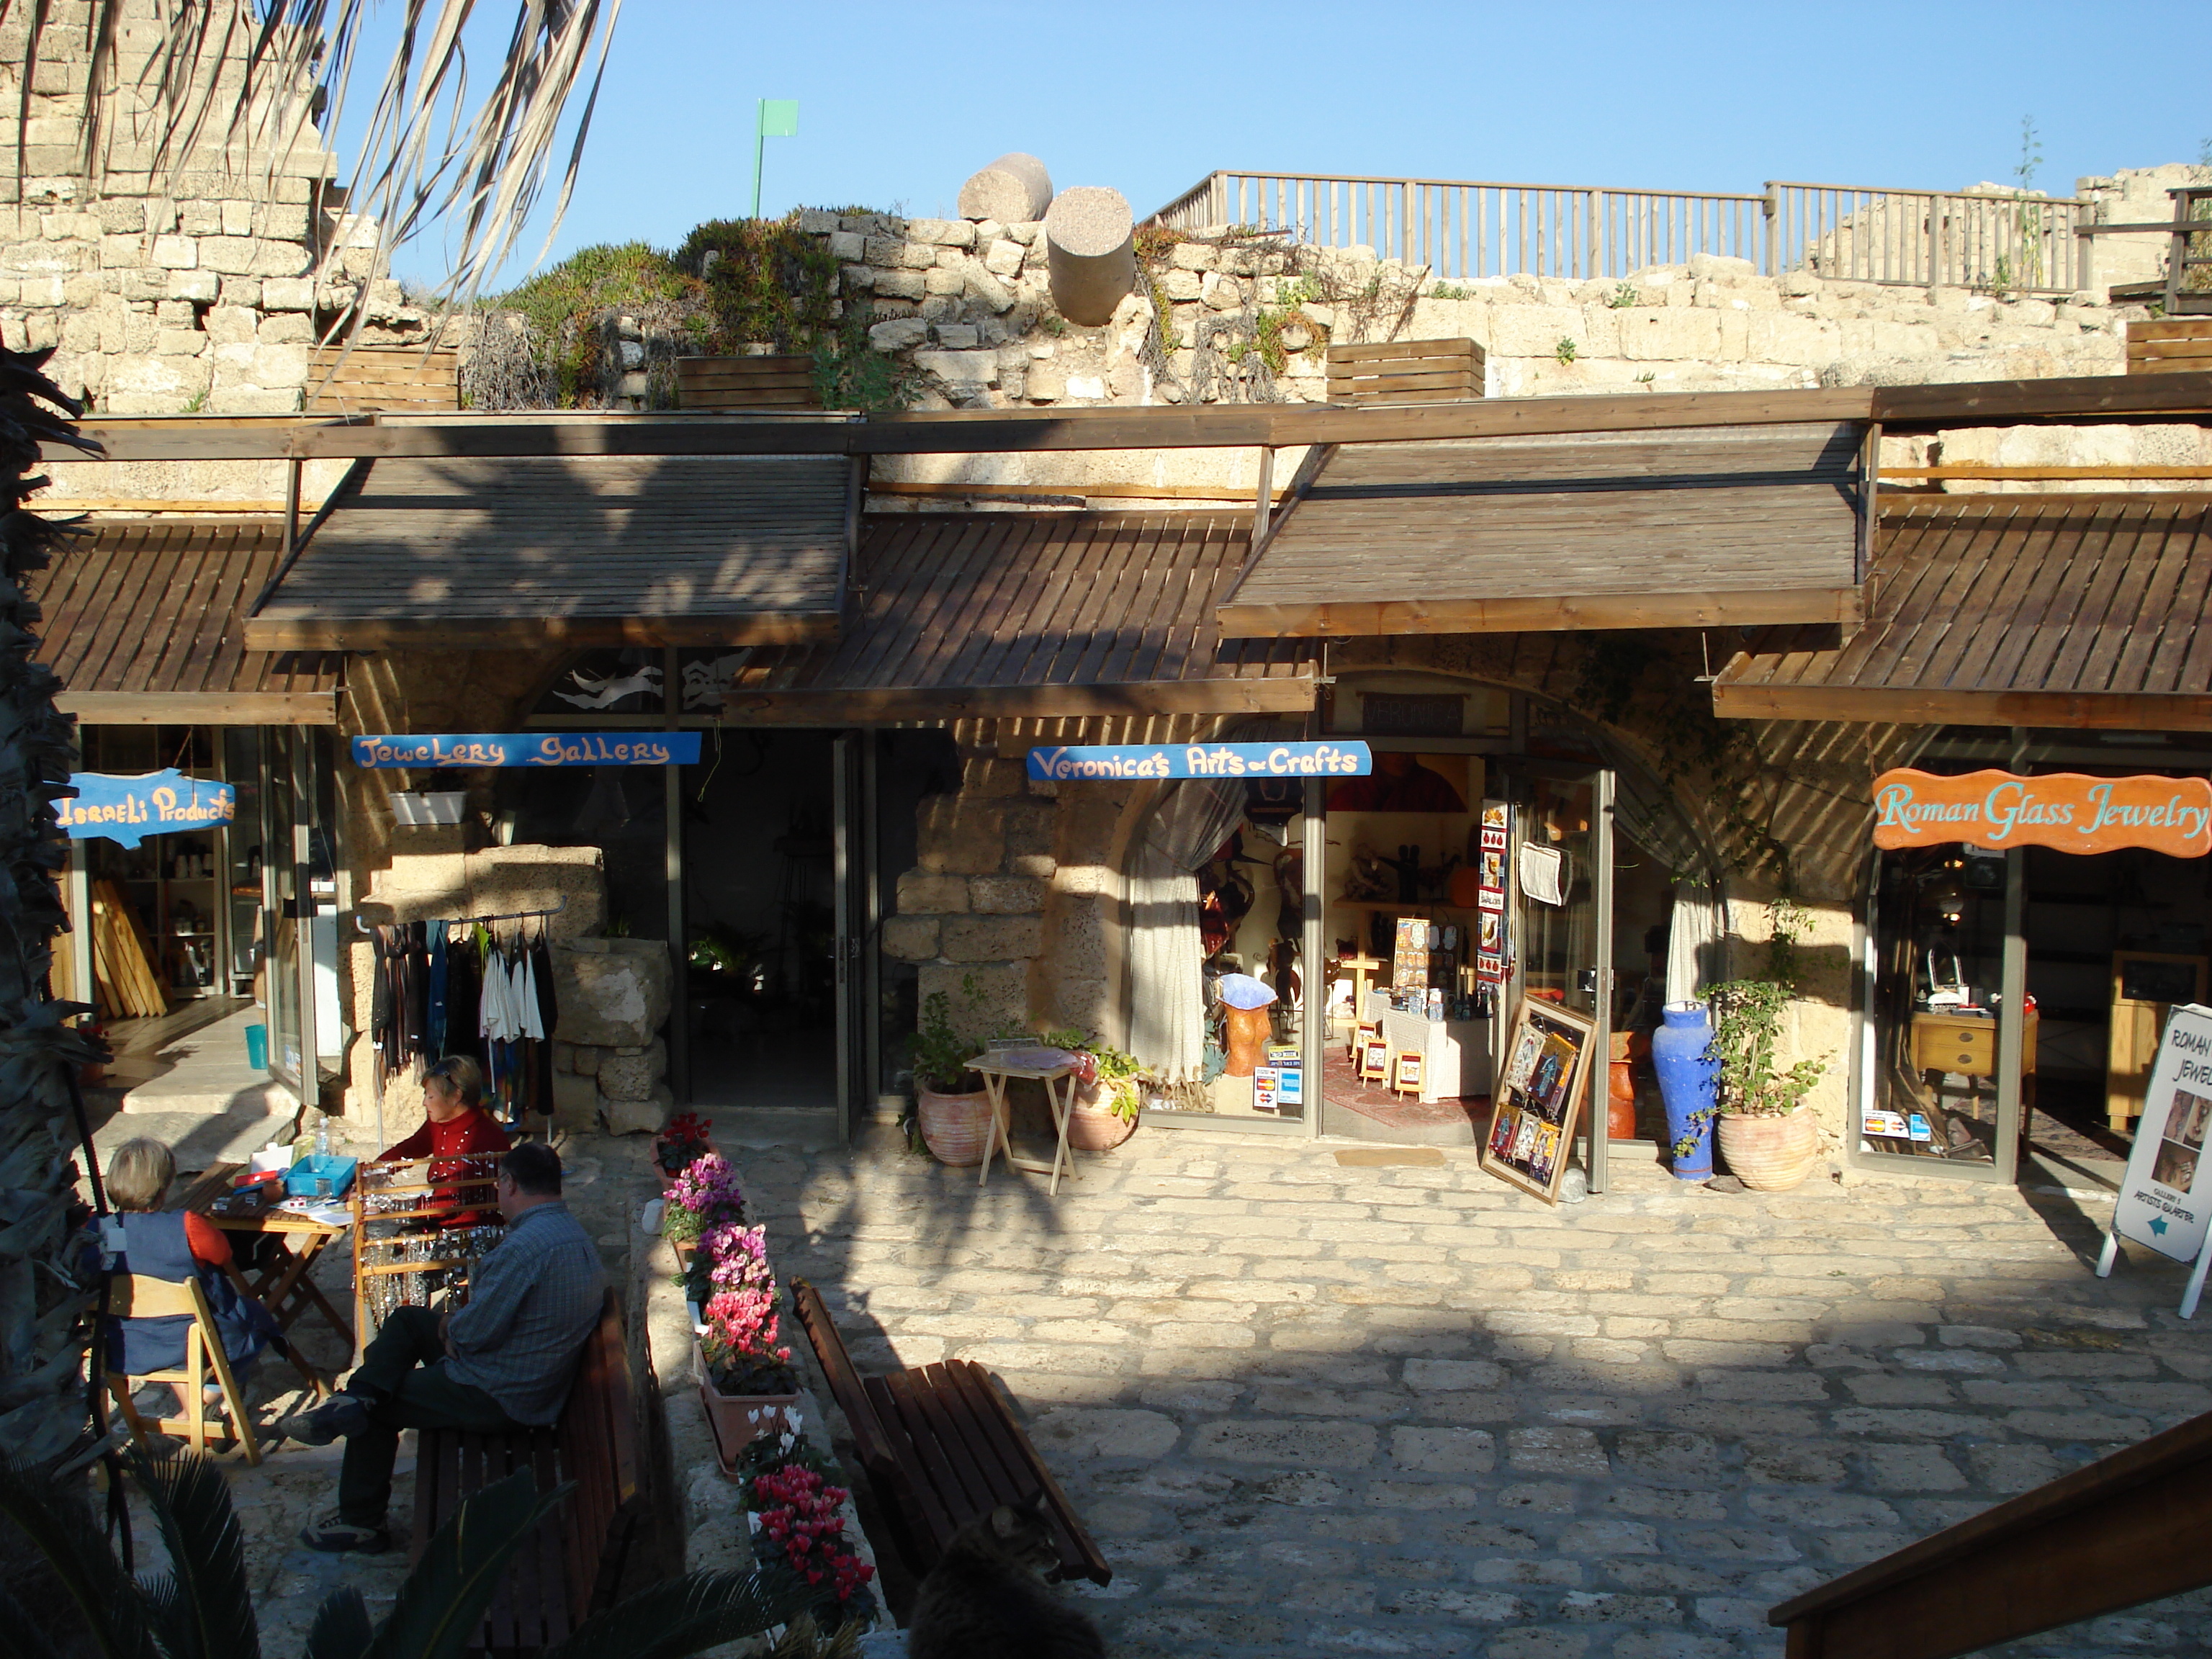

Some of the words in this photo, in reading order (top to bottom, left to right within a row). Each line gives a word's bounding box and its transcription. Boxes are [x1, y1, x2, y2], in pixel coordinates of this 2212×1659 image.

[1033, 747, 1170, 778] Veronica's
[1187, 746, 1246, 775] Arts
[1268, 745, 1358, 773] Crafts
[152, 786, 235, 822] Products
[1875, 783, 1980, 834] Roman
[1984, 781, 2075, 840] Glass
[2077, 783, 2211, 840] Jewelry
[2171, 1029, 2211, 1057] ROMAN
[2133, 1190, 2162, 1209] ARTISTS
[2162, 1202, 2195, 1223] QUARTER
